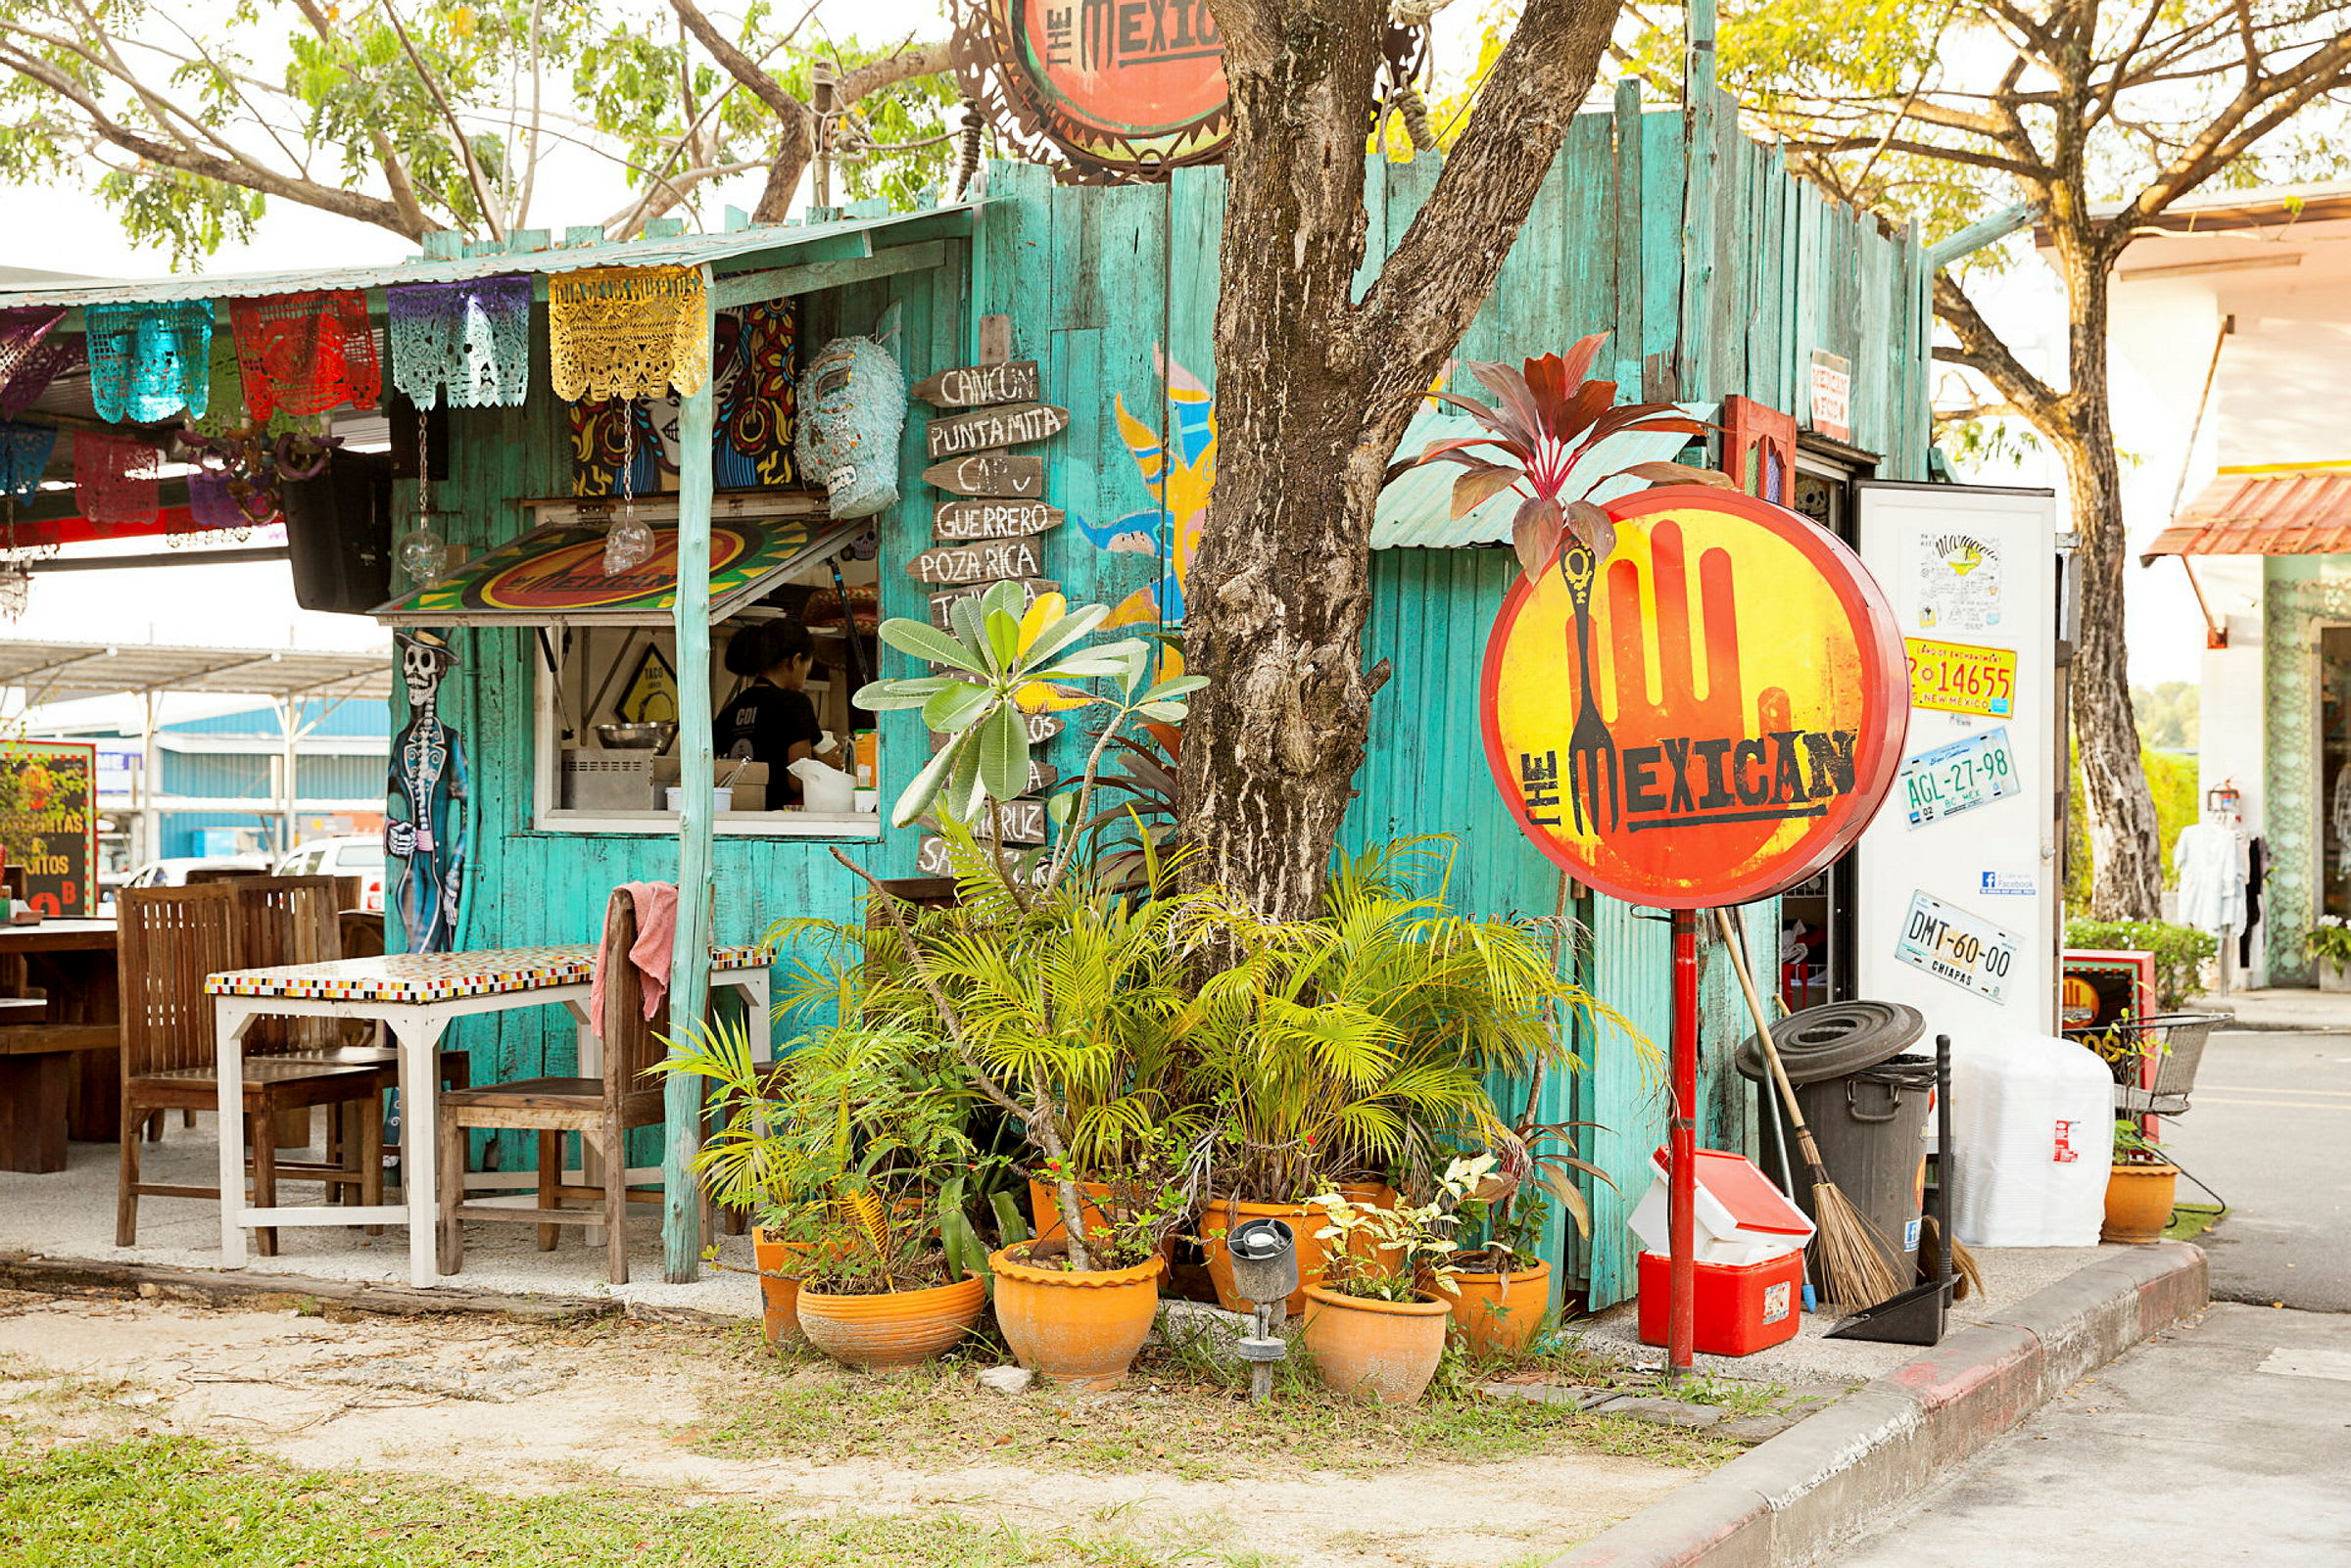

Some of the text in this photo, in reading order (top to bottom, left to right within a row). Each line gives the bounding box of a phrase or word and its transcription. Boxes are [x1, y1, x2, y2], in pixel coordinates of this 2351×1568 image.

[1046, 7, 1072, 71] THE
[937, 501, 1048, 538] GUERRERO
[920, 543, 1038, 583] POZA RICA
[644, 666, 664, 680] TACO
[1924, 693, 1945, 705] NEW
[1949, 695, 1990, 709] MEXICO
[1520, 730, 1858, 835] THE MEXICAN
[1907, 749, 2008, 809] AGL-27-98
[1908, 910, 2011, 977] DMT-60-00
[1932, 960, 1973, 986] CHIAPAS
